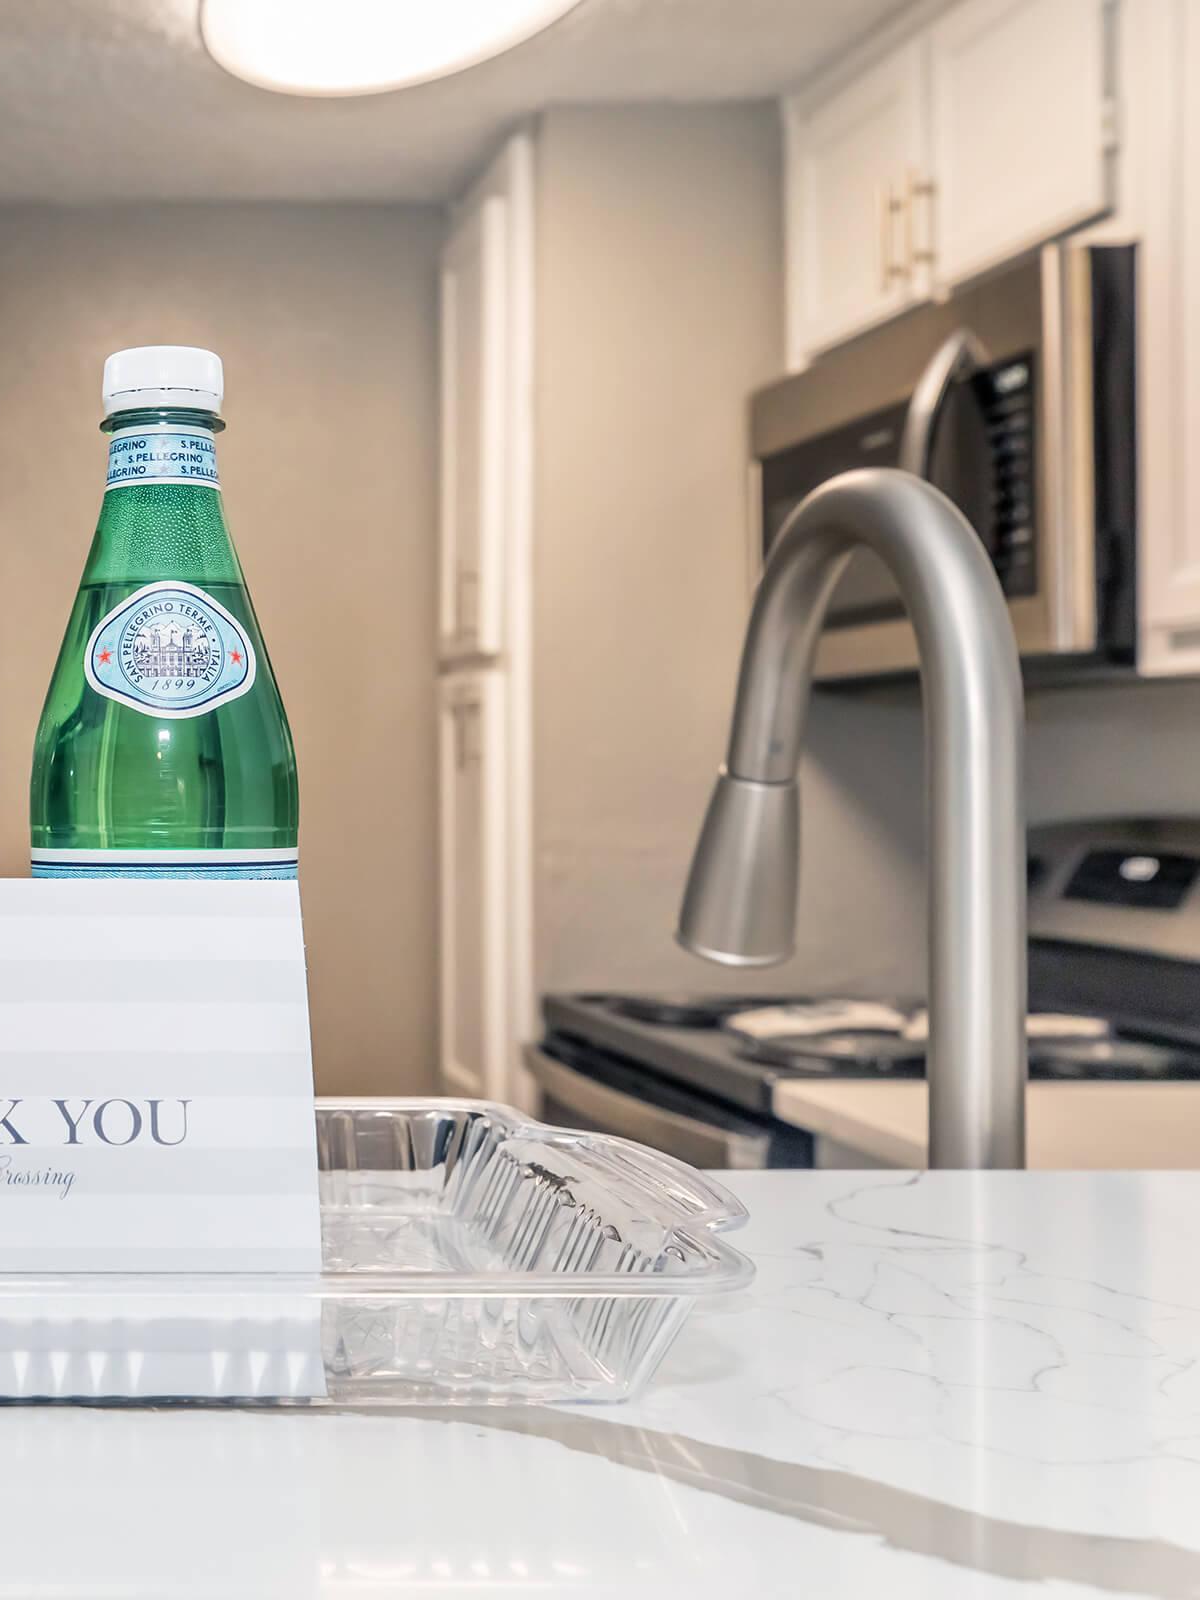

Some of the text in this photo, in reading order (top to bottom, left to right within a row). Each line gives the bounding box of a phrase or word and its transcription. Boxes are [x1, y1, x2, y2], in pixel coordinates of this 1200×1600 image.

[123, 602, 221, 683] SAN PELLEGRINO TERME ITALIA
[151, 679, 196, 691] 1899
[51, 1098, 193, 1146] YOU
